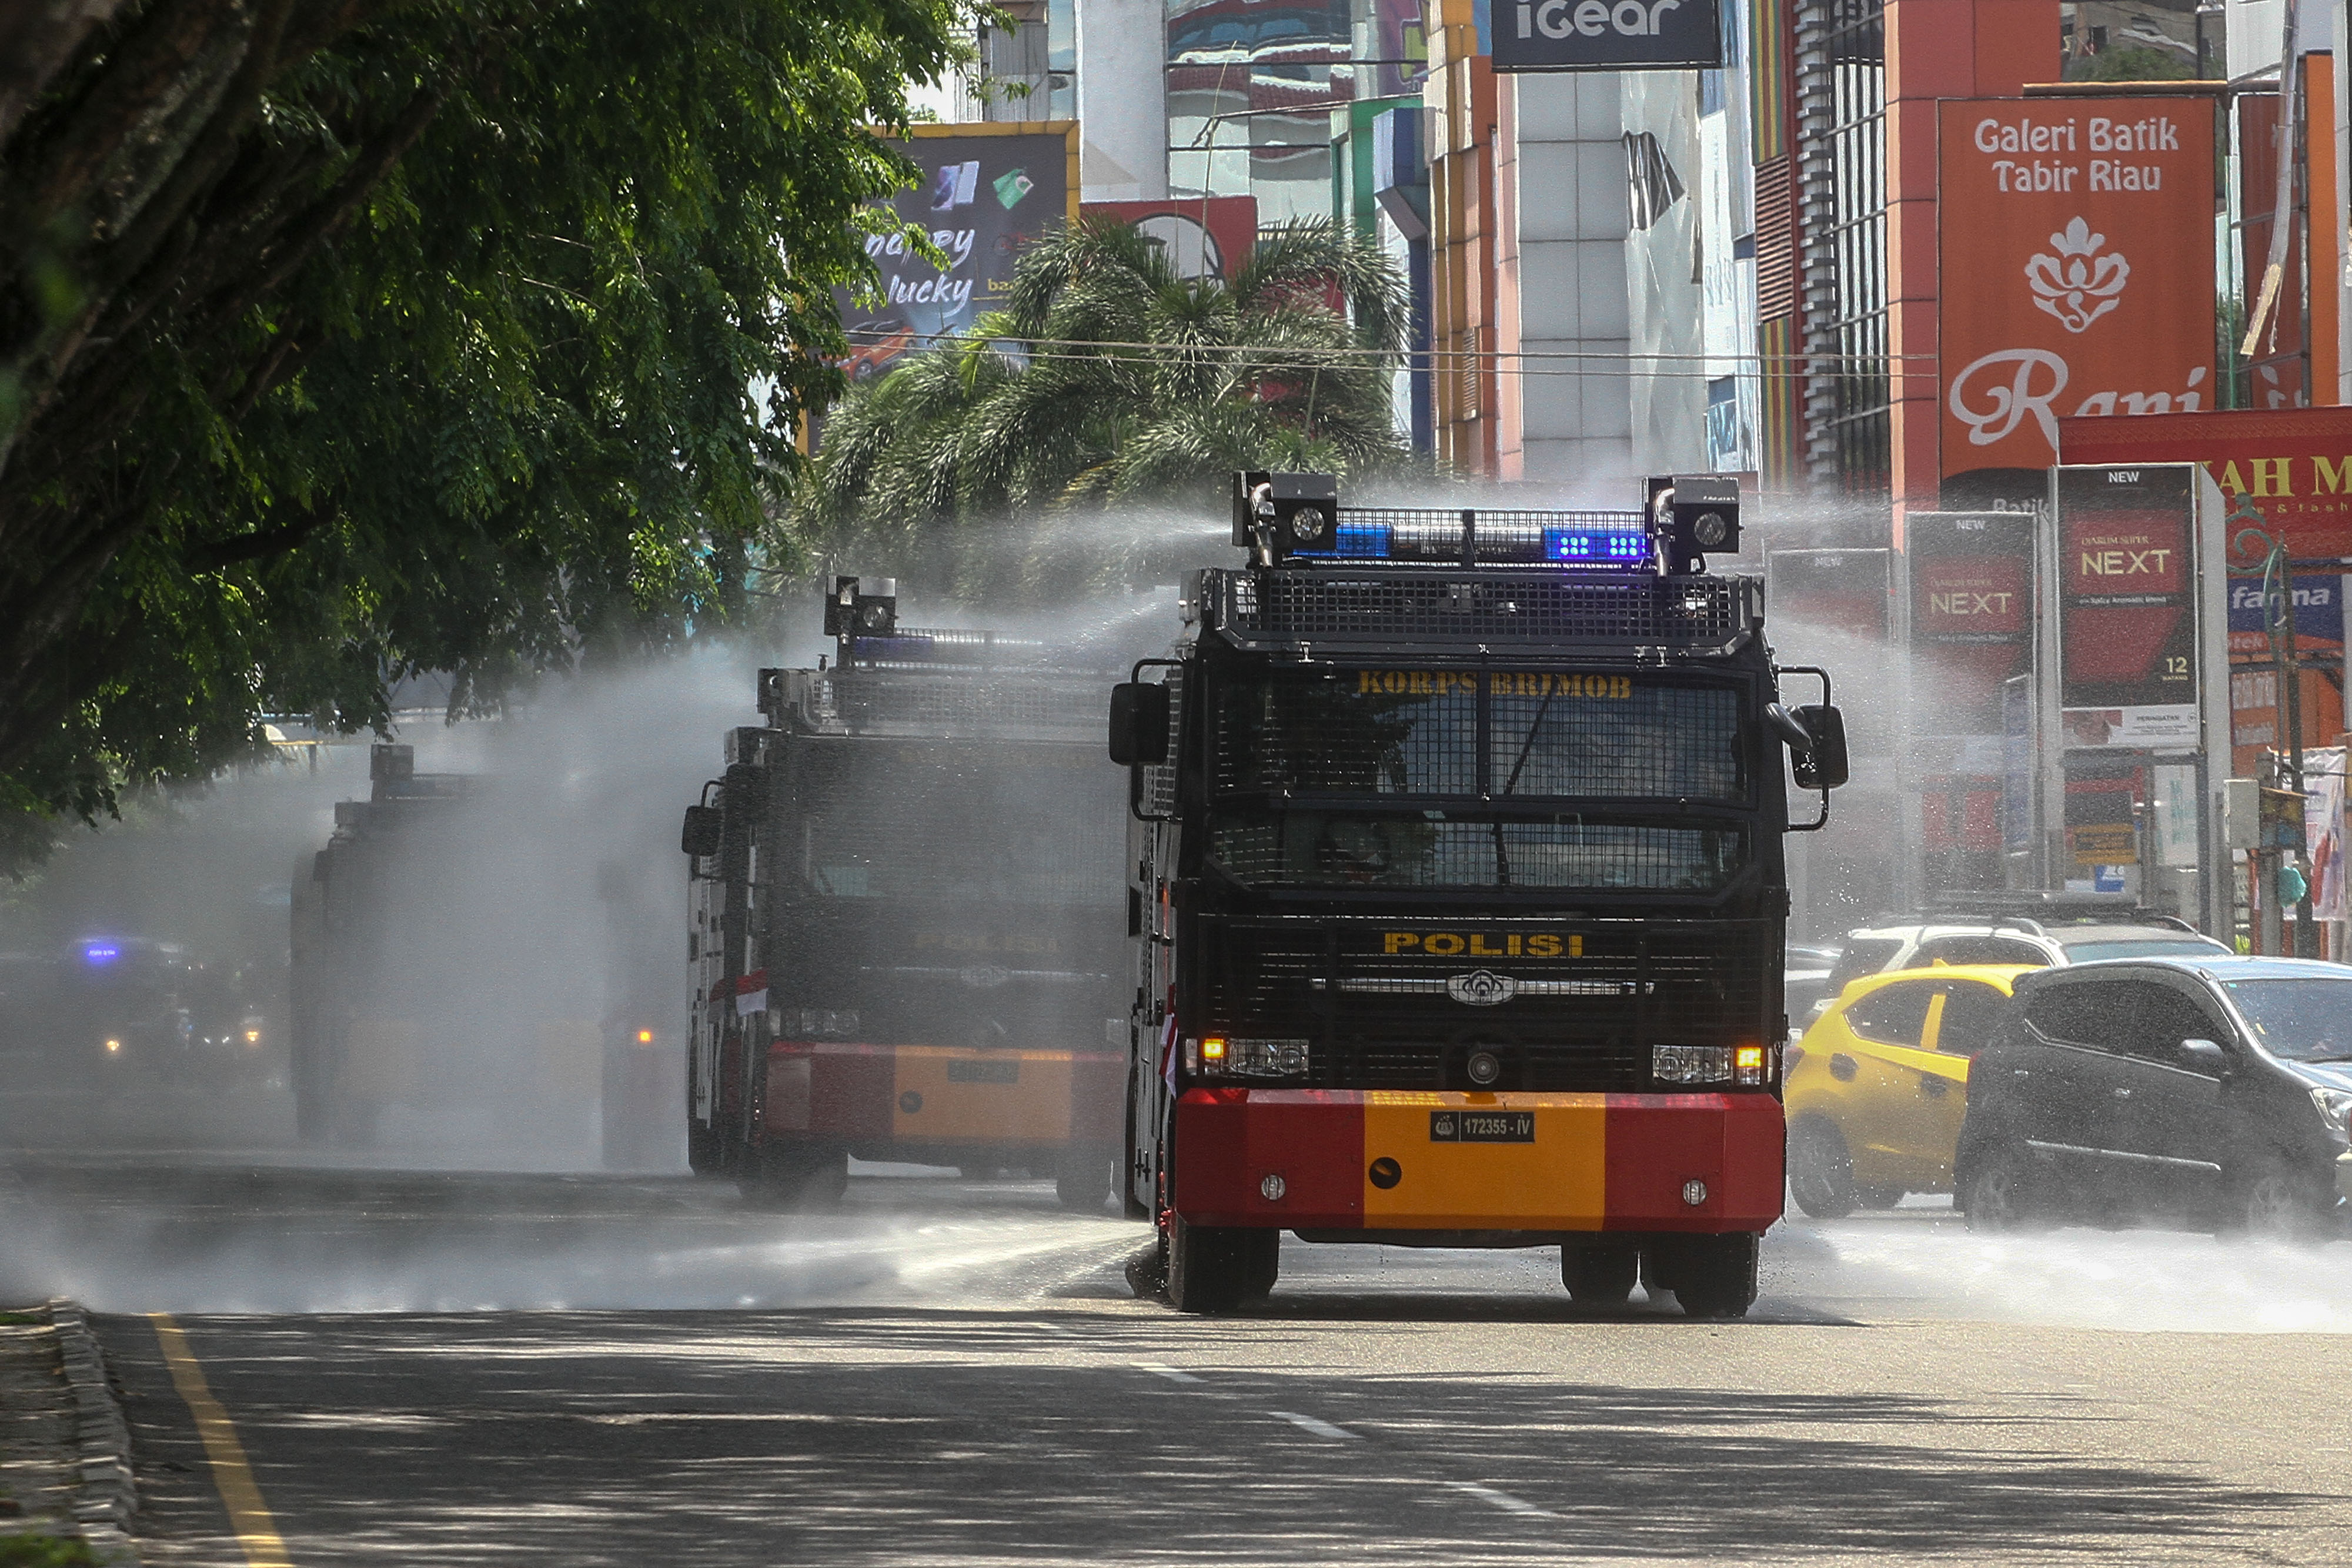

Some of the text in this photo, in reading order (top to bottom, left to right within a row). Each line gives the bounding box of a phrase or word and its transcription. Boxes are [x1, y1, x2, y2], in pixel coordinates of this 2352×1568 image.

[1975, 117, 2179, 153] Galeri Batik
[1992, 159, 2161, 192] Tabir Riau
[888, 273, 974, 318] lucky
[2108, 471, 2140, 483] NEW
[1956, 520, 1986, 530] NEW
[2082, 549, 2171, 576] NEXT
[1931, 592, 2012, 614] NEXT
[2166, 656, 2187, 673] 12
[1358, 670, 1632, 698] KORPS BRIMOB
[1384, 932, 1583, 957] POLISI
[1465, 1118, 1506, 1135] 172355
